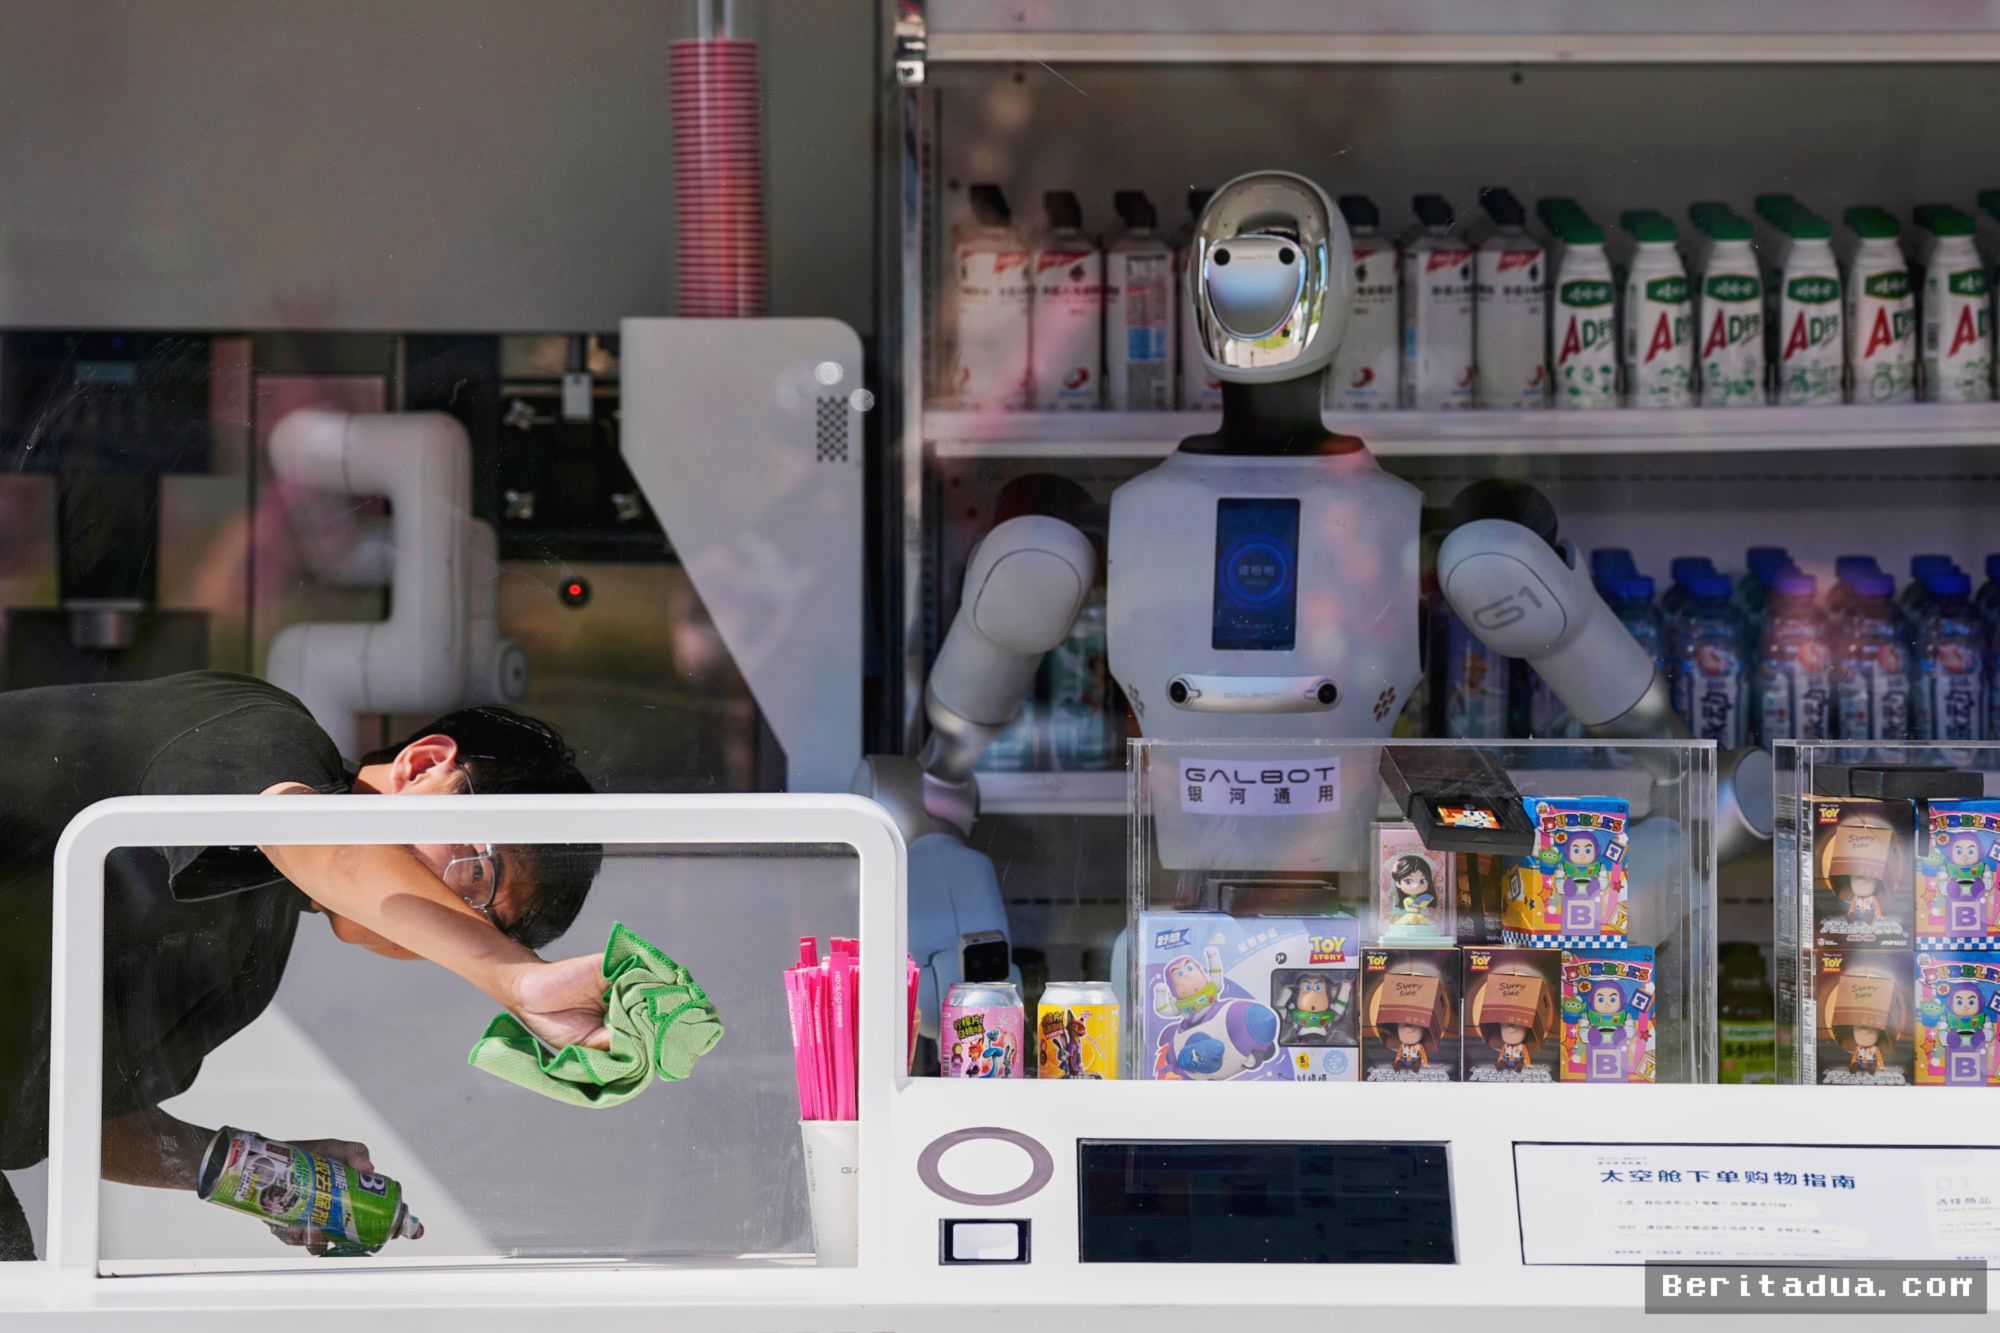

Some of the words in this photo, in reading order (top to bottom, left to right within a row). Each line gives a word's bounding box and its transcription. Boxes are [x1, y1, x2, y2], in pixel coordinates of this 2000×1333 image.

[1473, 586, 1543, 630] G1
[1185, 767, 1335, 784] GALBOT
[1187, 784, 1334, 805] 银河通用
[1819, 808, 1840, 818] TOY
[1542, 813, 1622, 832] BUBBLES
[1310, 936, 1347, 953] TOY
[1312, 953, 1343, 961] STORY
[1367, 956, 1388, 965] TOY
[1470, 956, 1491, 965] TOY
[1822, 957, 1843, 968] TOY
[1565, 962, 1650, 981] BUBBLES
[1396, 982, 1423, 991] Sunny
[1499, 982, 1527, 991] Sunny
[1600, 1169, 1856, 1190] 太空舱下单购物指南
